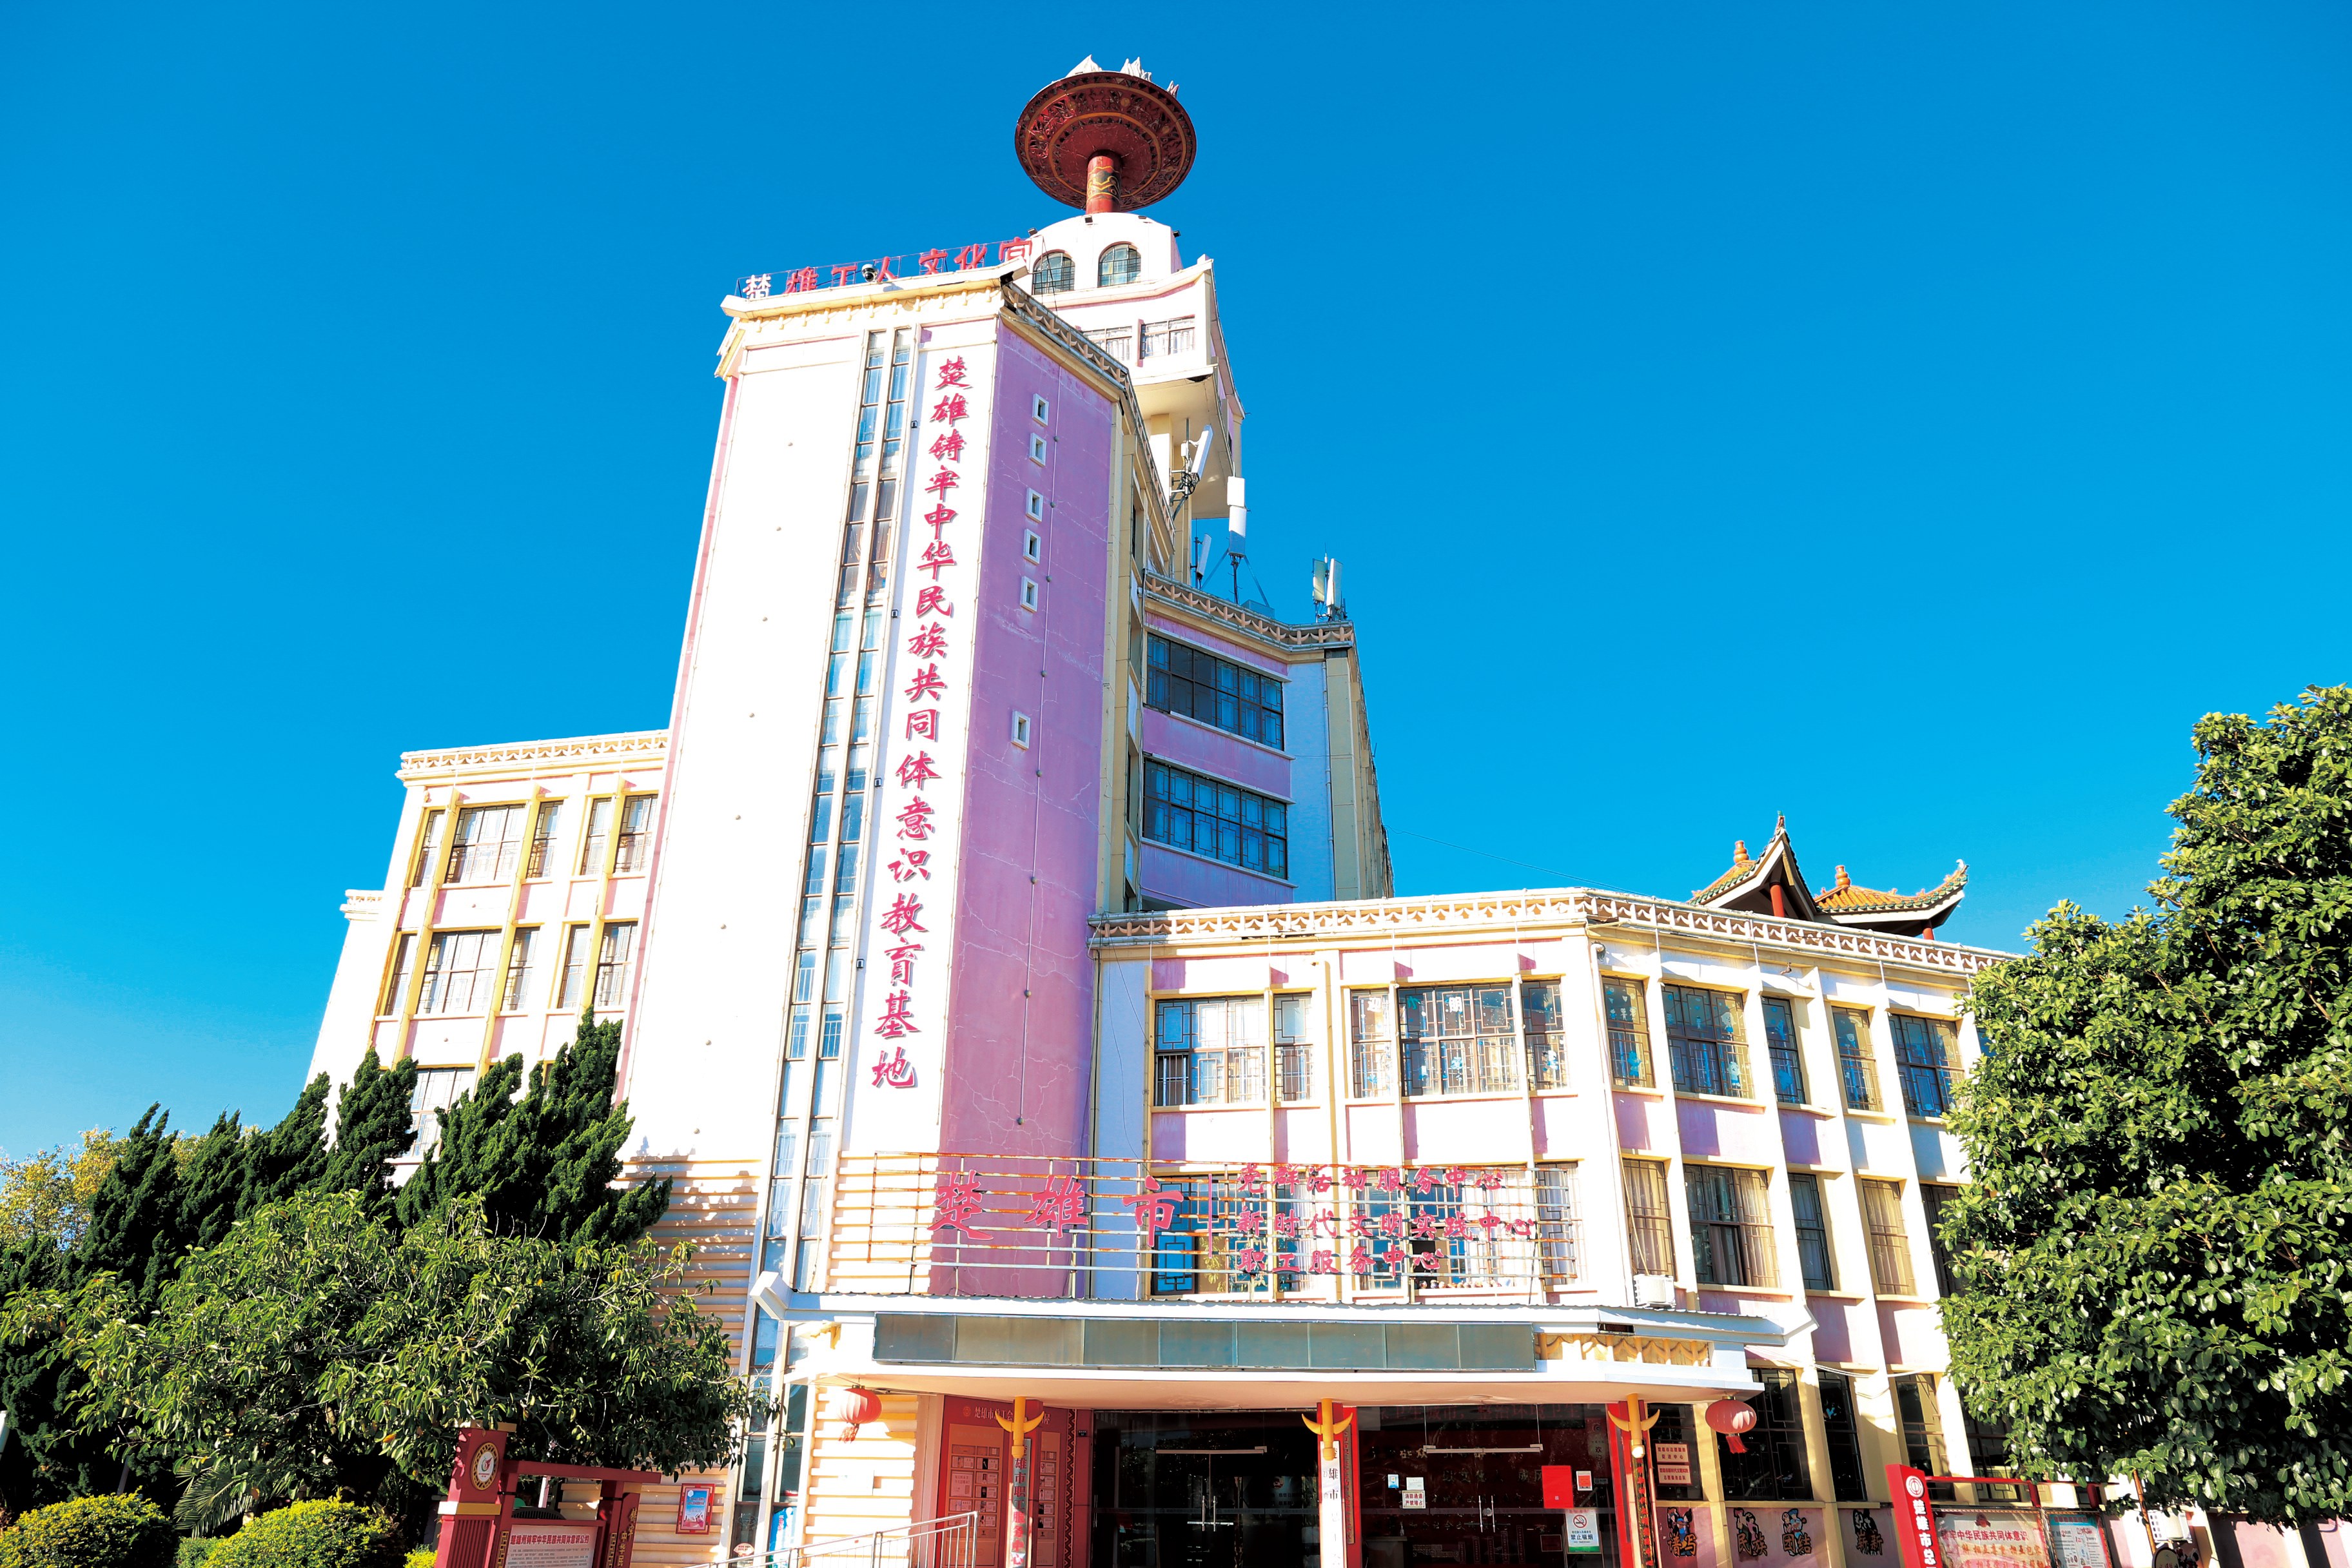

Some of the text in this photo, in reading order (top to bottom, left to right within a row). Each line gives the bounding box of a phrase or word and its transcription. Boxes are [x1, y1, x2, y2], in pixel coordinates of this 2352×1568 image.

[743, 237, 1032, 299] 楚雄工人文化宫
[872, 356, 971, 1087] 楚雄铸牢中华民族共同体意识教育基地
[1237, 1163, 1504, 1197] 党群活动服务中心
[927, 1170, 1184, 1248] 楚雄市
[1236, 1205, 1536, 1241] 新时代文明实践中心
[1237, 1244, 1445, 1276] 职工服务中心
[1737, 1531, 1768, 1556] 民族
[1781, 1532, 1812, 1555] 团结
[1912, 1499, 1937, 1568] 楚雄市总
